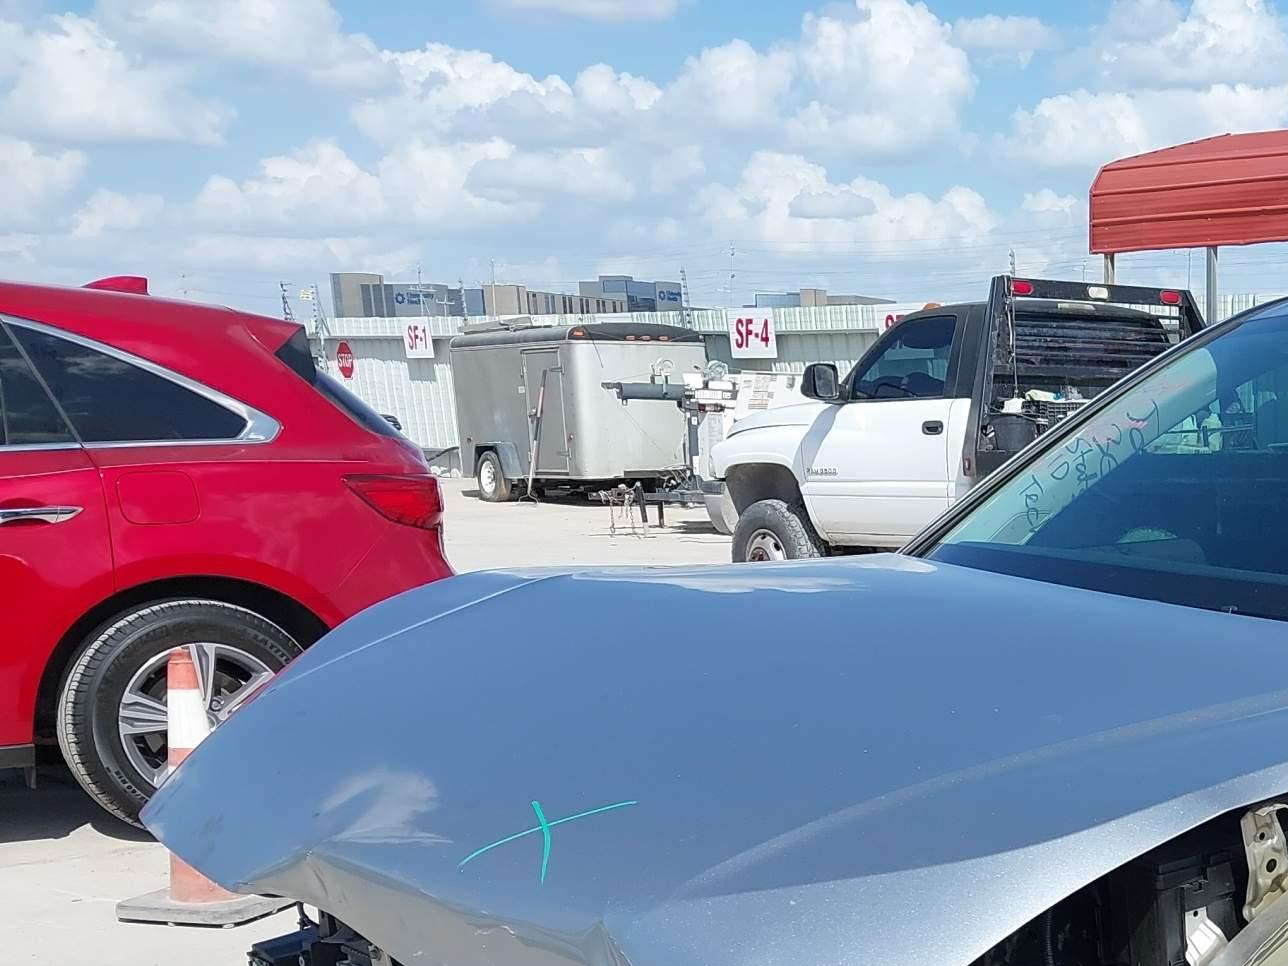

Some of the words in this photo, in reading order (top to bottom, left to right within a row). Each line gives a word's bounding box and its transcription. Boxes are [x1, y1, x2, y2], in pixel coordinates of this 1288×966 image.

[407, 325, 428, 350] SF-1
[735, 318, 770, 349] SF-4
[337, 353, 353, 368] STOP
